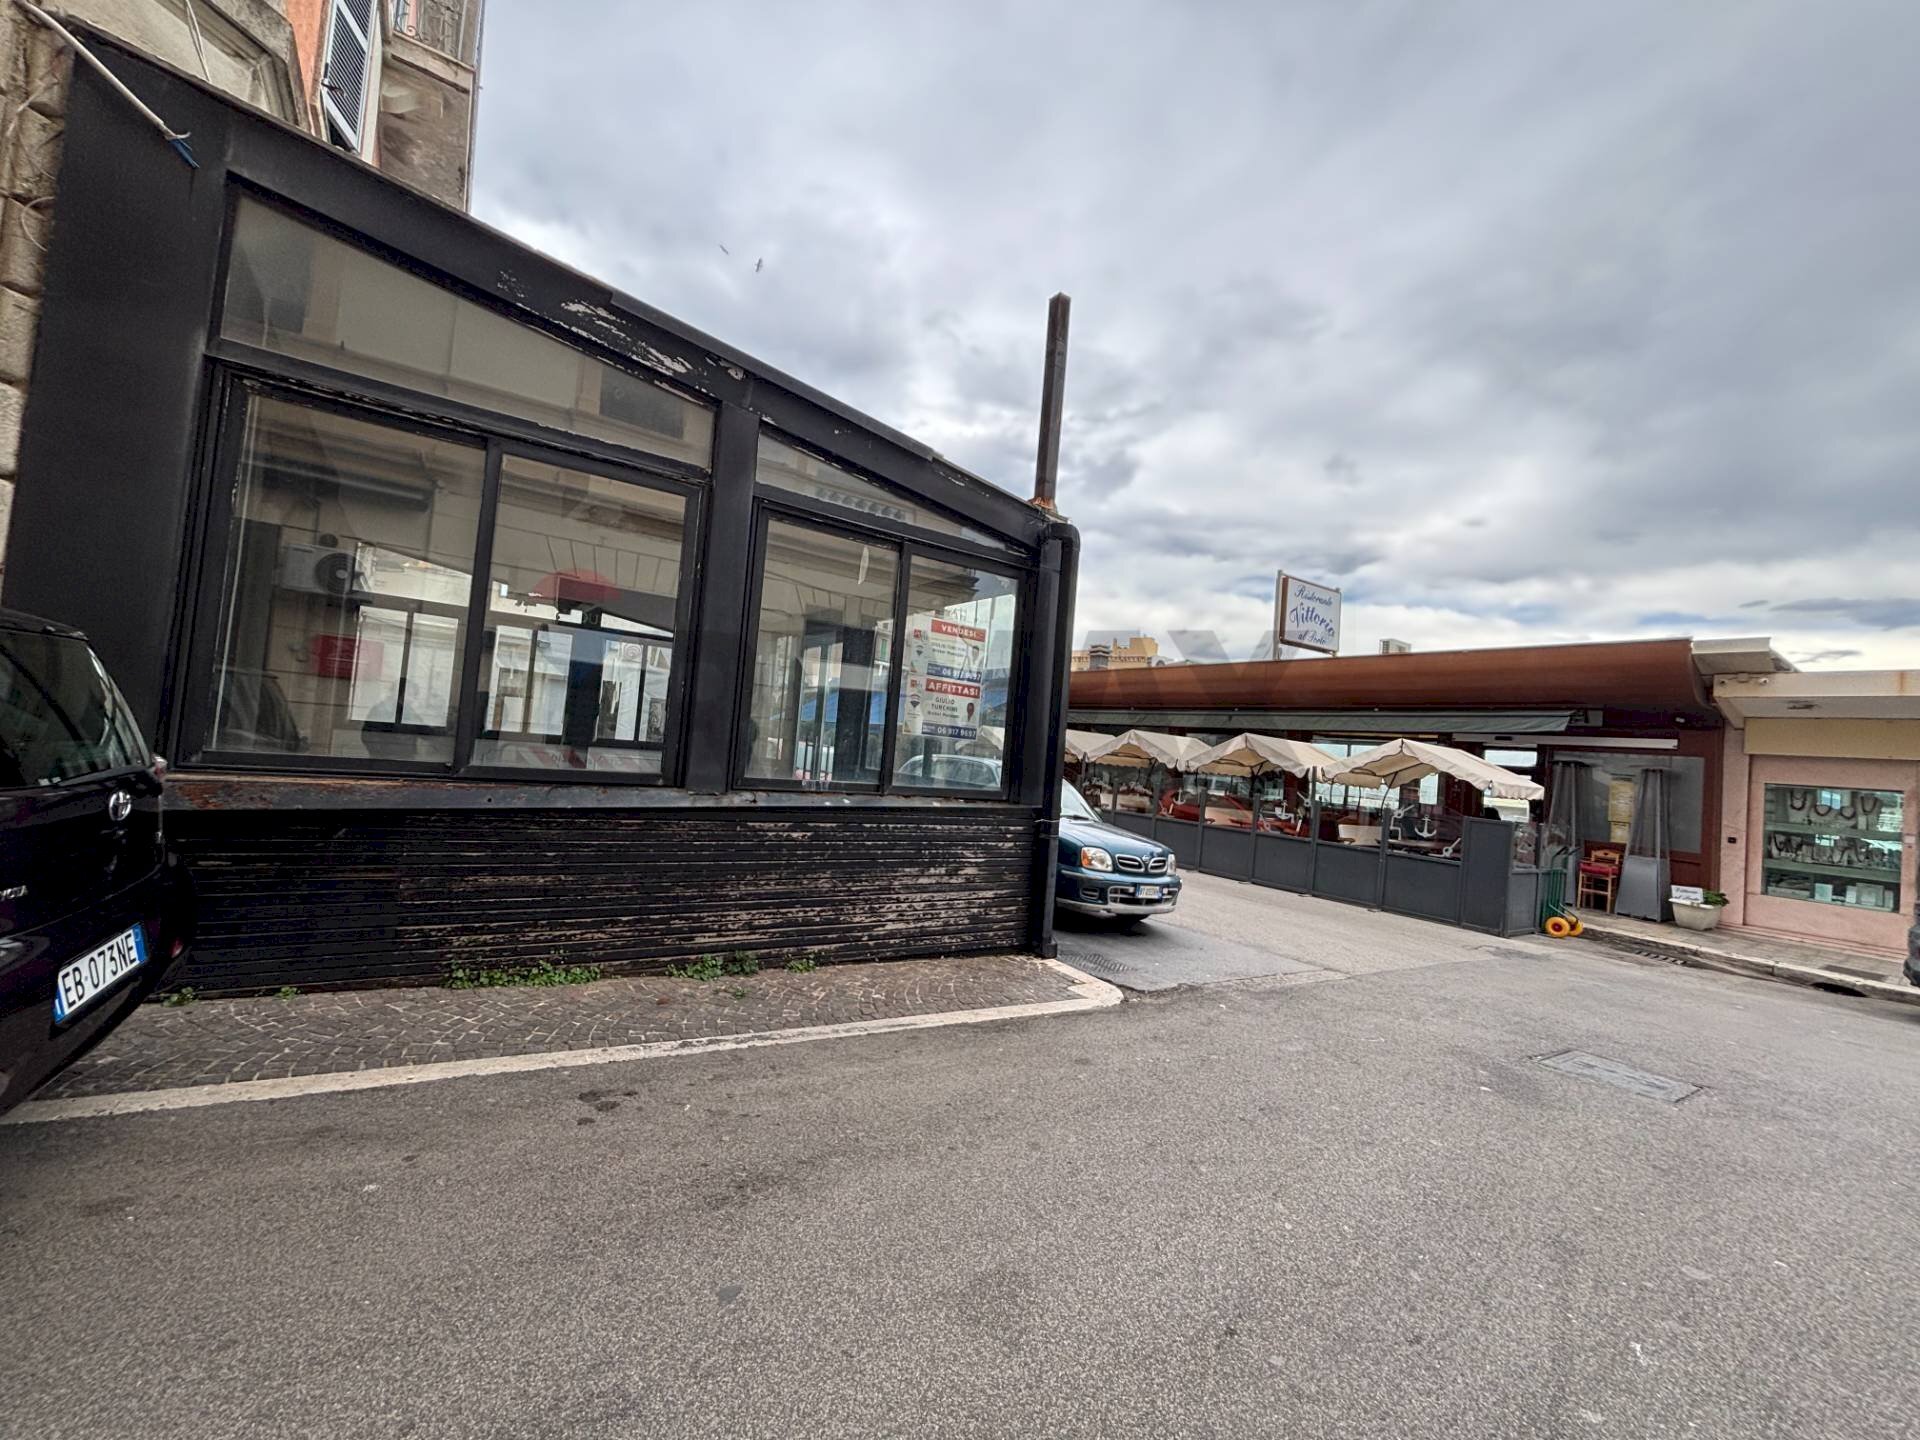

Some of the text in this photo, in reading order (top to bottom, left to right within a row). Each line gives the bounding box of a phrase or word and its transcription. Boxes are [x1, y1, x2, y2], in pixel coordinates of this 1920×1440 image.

[1289, 601, 1336, 638] Vittoria
[941, 623, 977, 638] VENDESI
[928, 681, 979, 696] AFFITTASI
